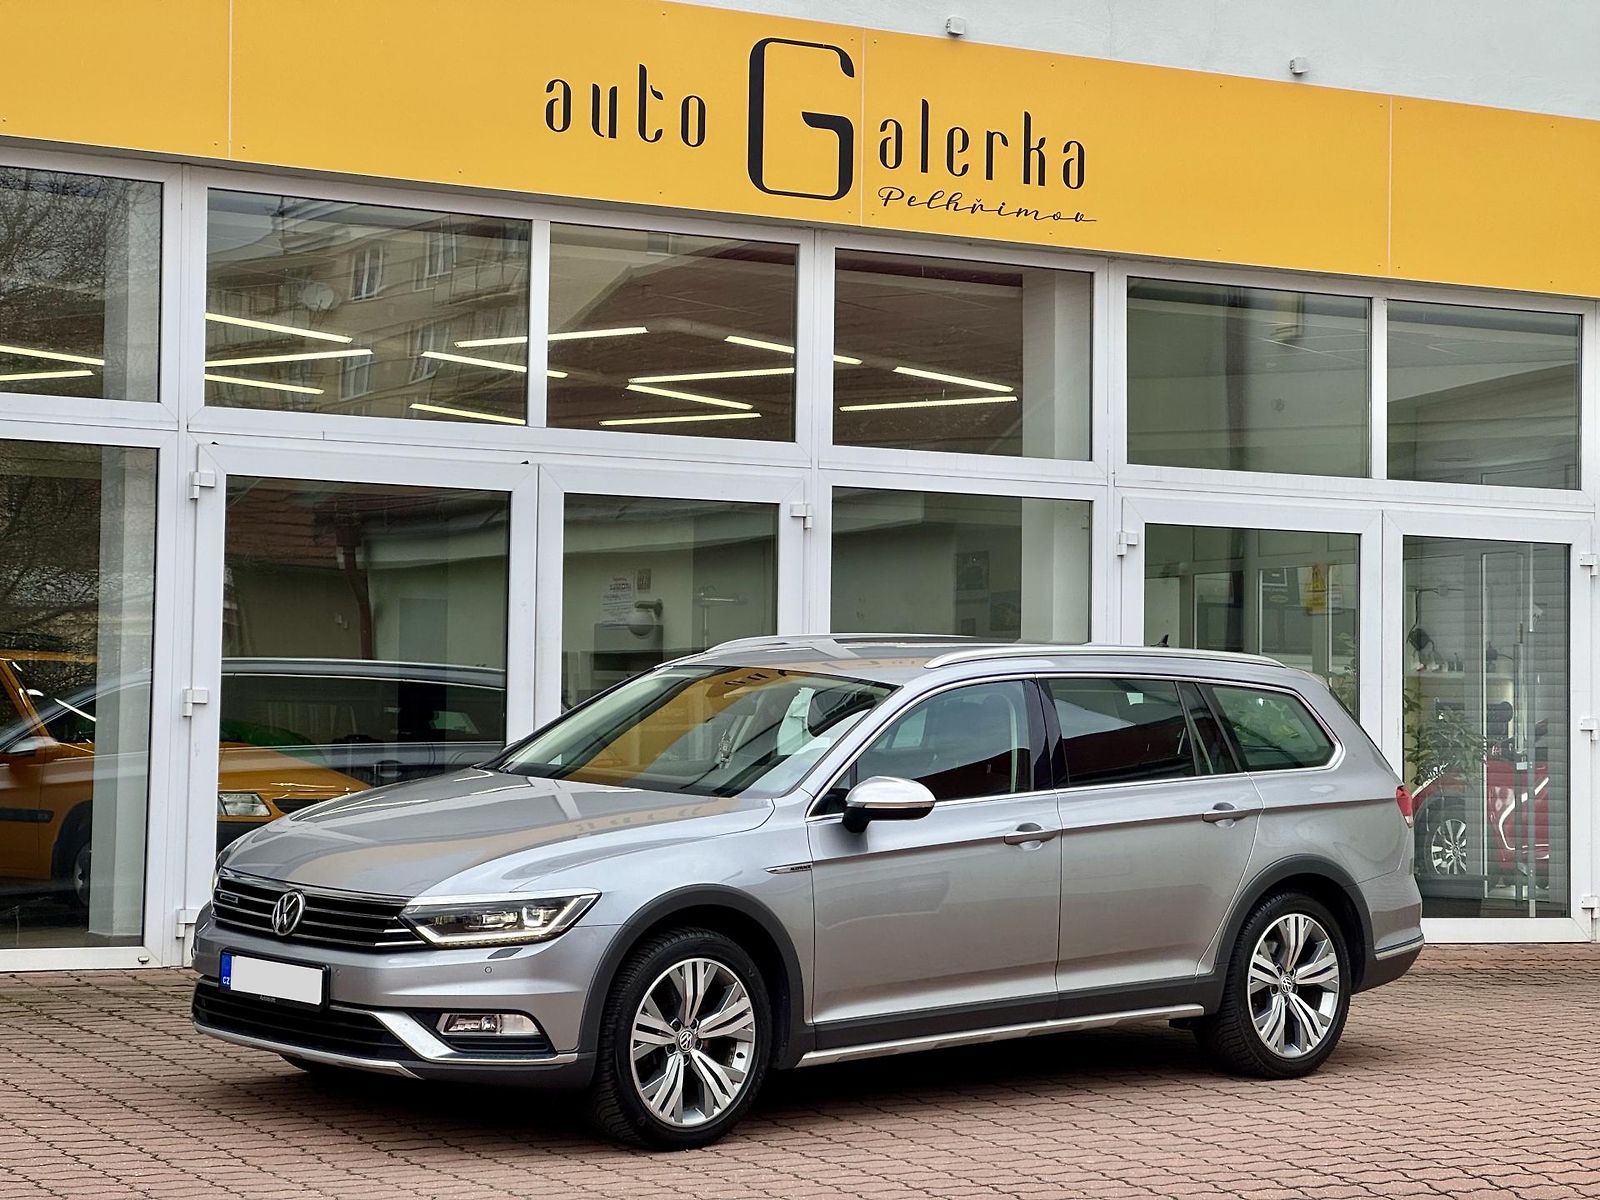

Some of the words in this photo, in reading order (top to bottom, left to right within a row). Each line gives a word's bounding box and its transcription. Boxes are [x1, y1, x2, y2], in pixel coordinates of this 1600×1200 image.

[545, 63, 707, 148] auto
[748, 37, 1086, 200] Galerka
[877, 186, 1097, 223] Pelhřimov
